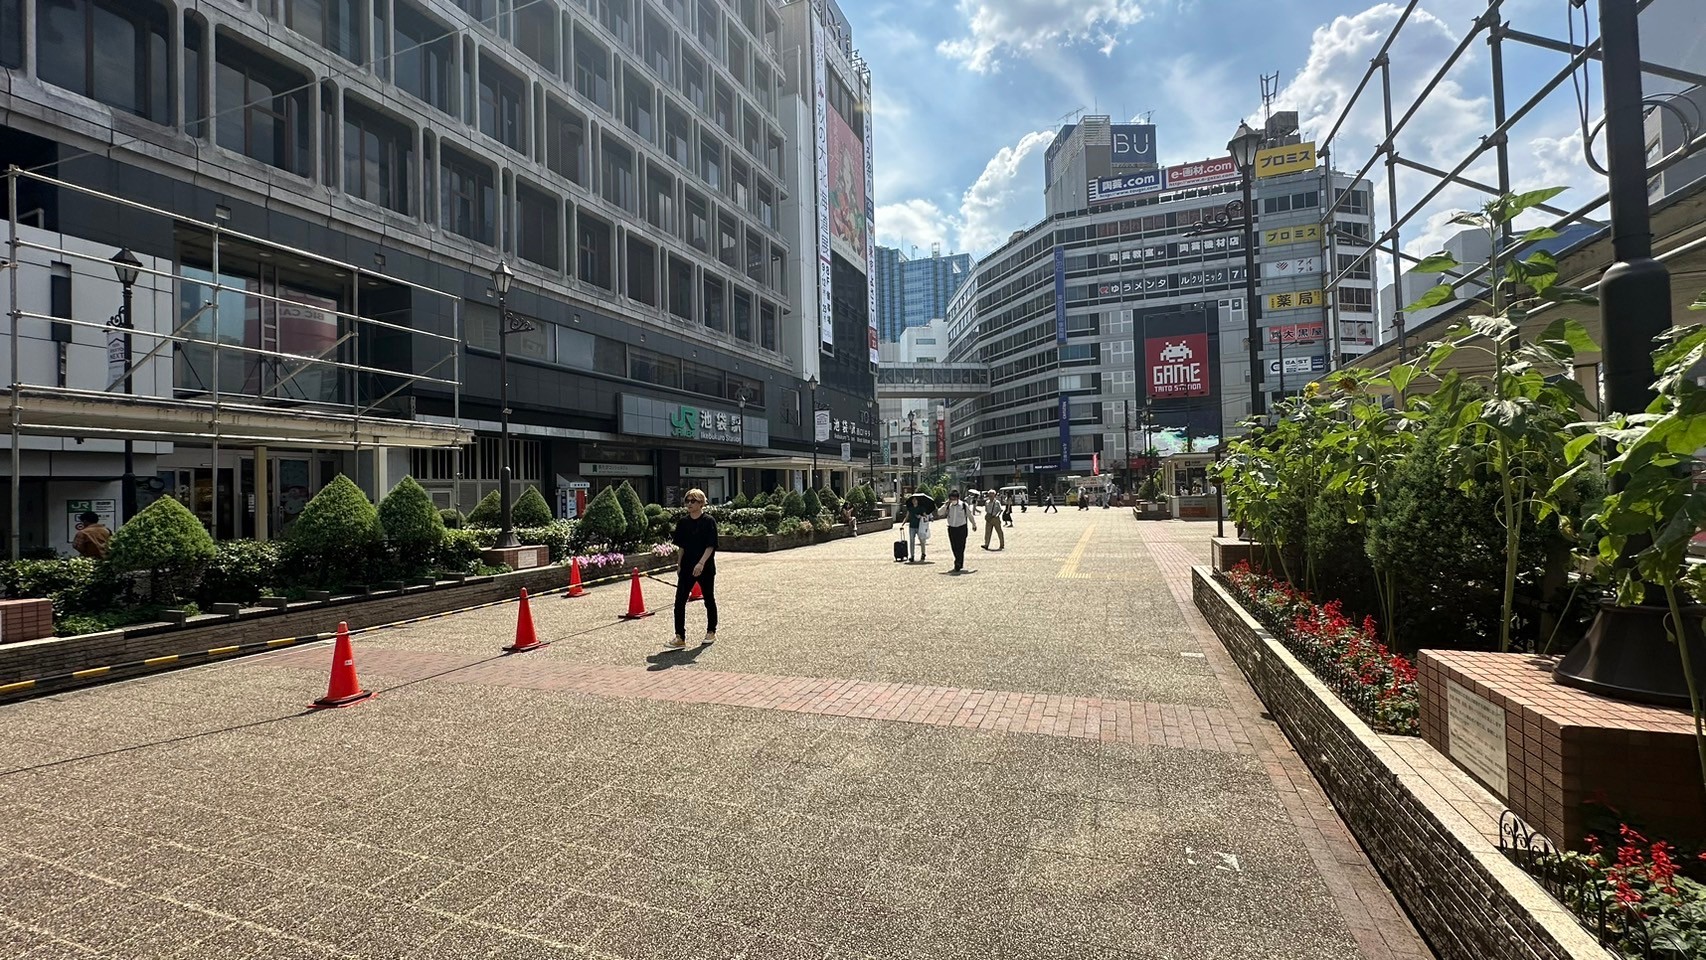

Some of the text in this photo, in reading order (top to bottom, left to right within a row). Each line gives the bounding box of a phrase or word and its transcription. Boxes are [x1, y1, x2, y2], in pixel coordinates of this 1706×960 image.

[1113, 133, 1149, 154] BU
[1260, 150, 1311, 168] プロミス
[1171, 162, 1232, 179] e-画材.com
[1267, 228, 1317, 242] プロミス
[1277, 292, 1313, 308] 薬局
[1153, 363, 1201, 385] GAME
[671, 405, 698, 430] JR
[700, 410, 741, 433] 池袋駅
[700, 431, 725, 442] Ikebukuro
[71, 501, 89, 509] JR
